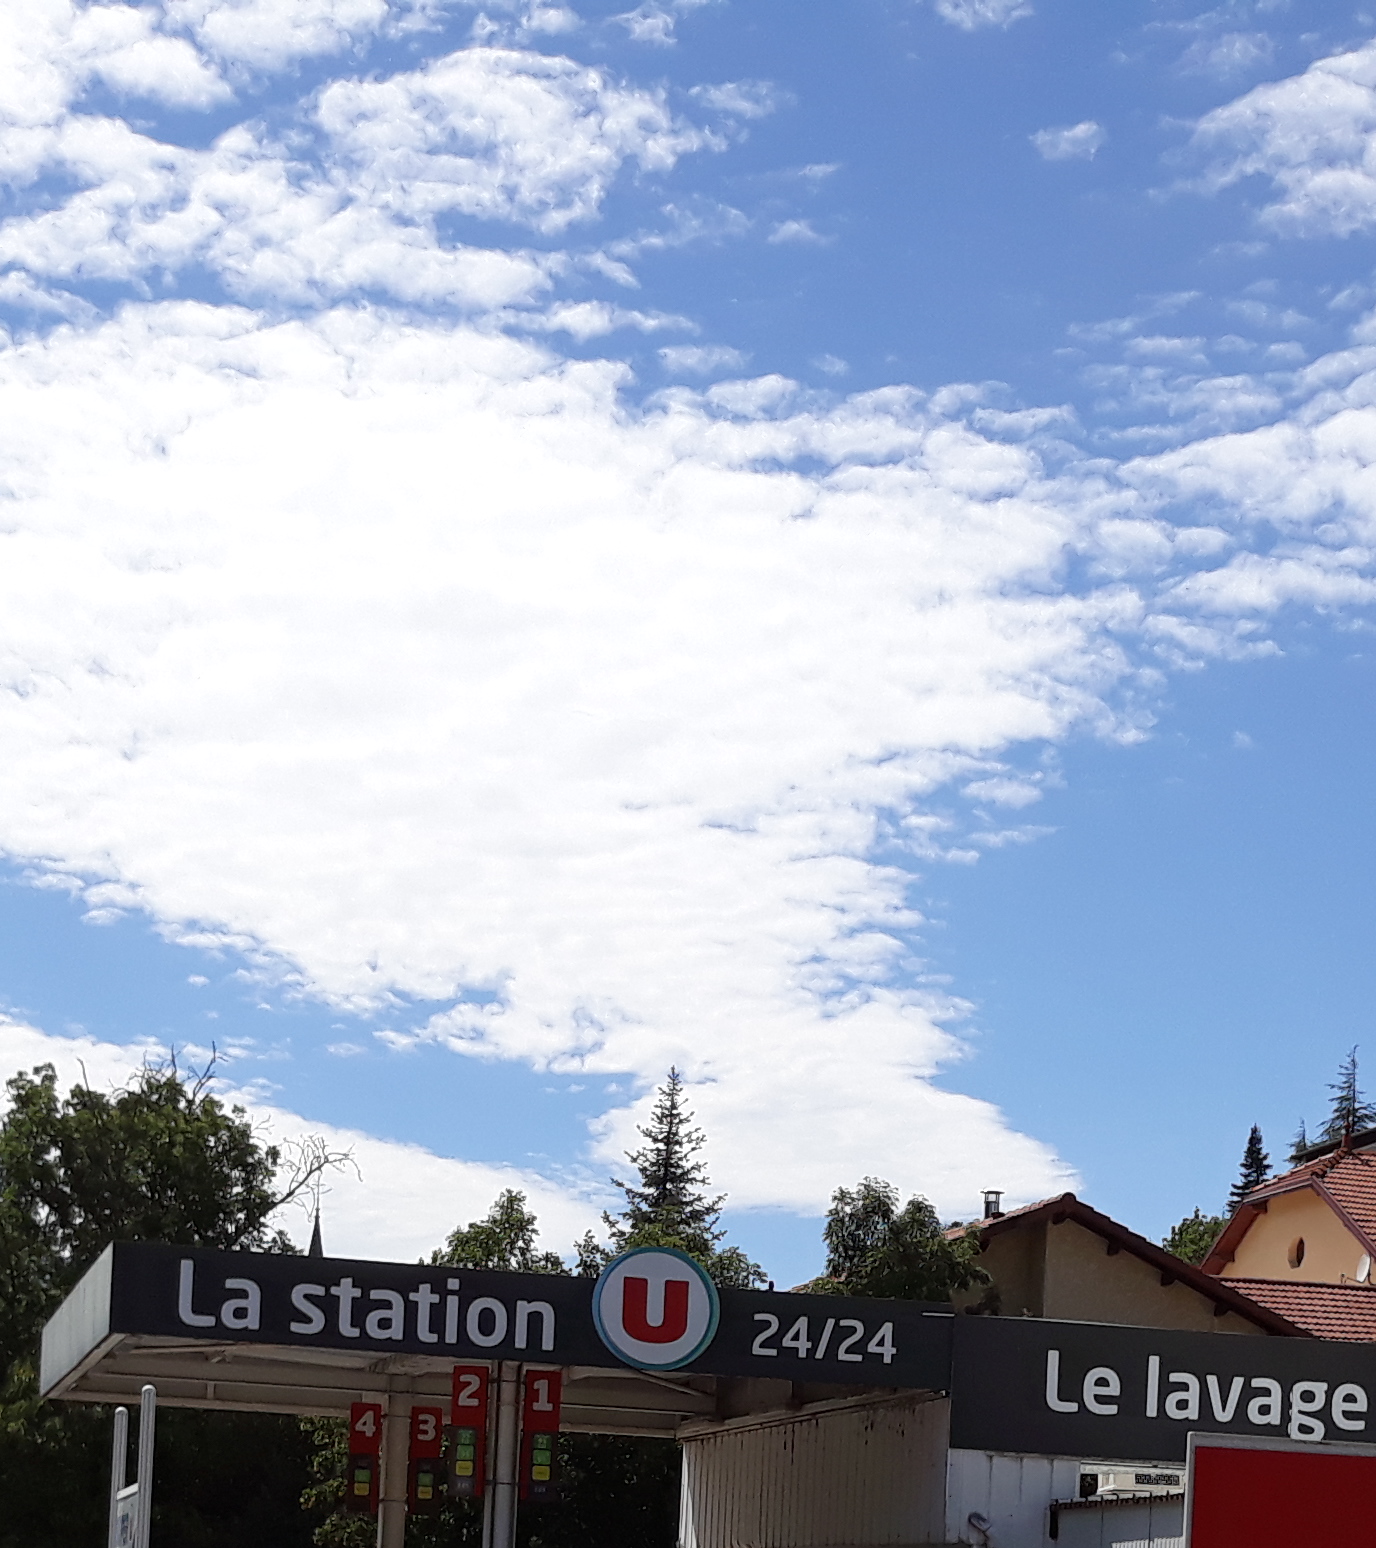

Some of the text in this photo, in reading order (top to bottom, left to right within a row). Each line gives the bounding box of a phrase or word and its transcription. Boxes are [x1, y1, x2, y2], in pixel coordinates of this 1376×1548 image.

[177, 1257, 897, 1364] La station U 24/24
[457, 1374, 481, 1406] 2
[532, 1379, 554, 1411] 1
[1045, 1349, 1368, 1441] Le lavage
[354, 1410, 376, 1437] 4
[417, 1413, 436, 1441] 3
